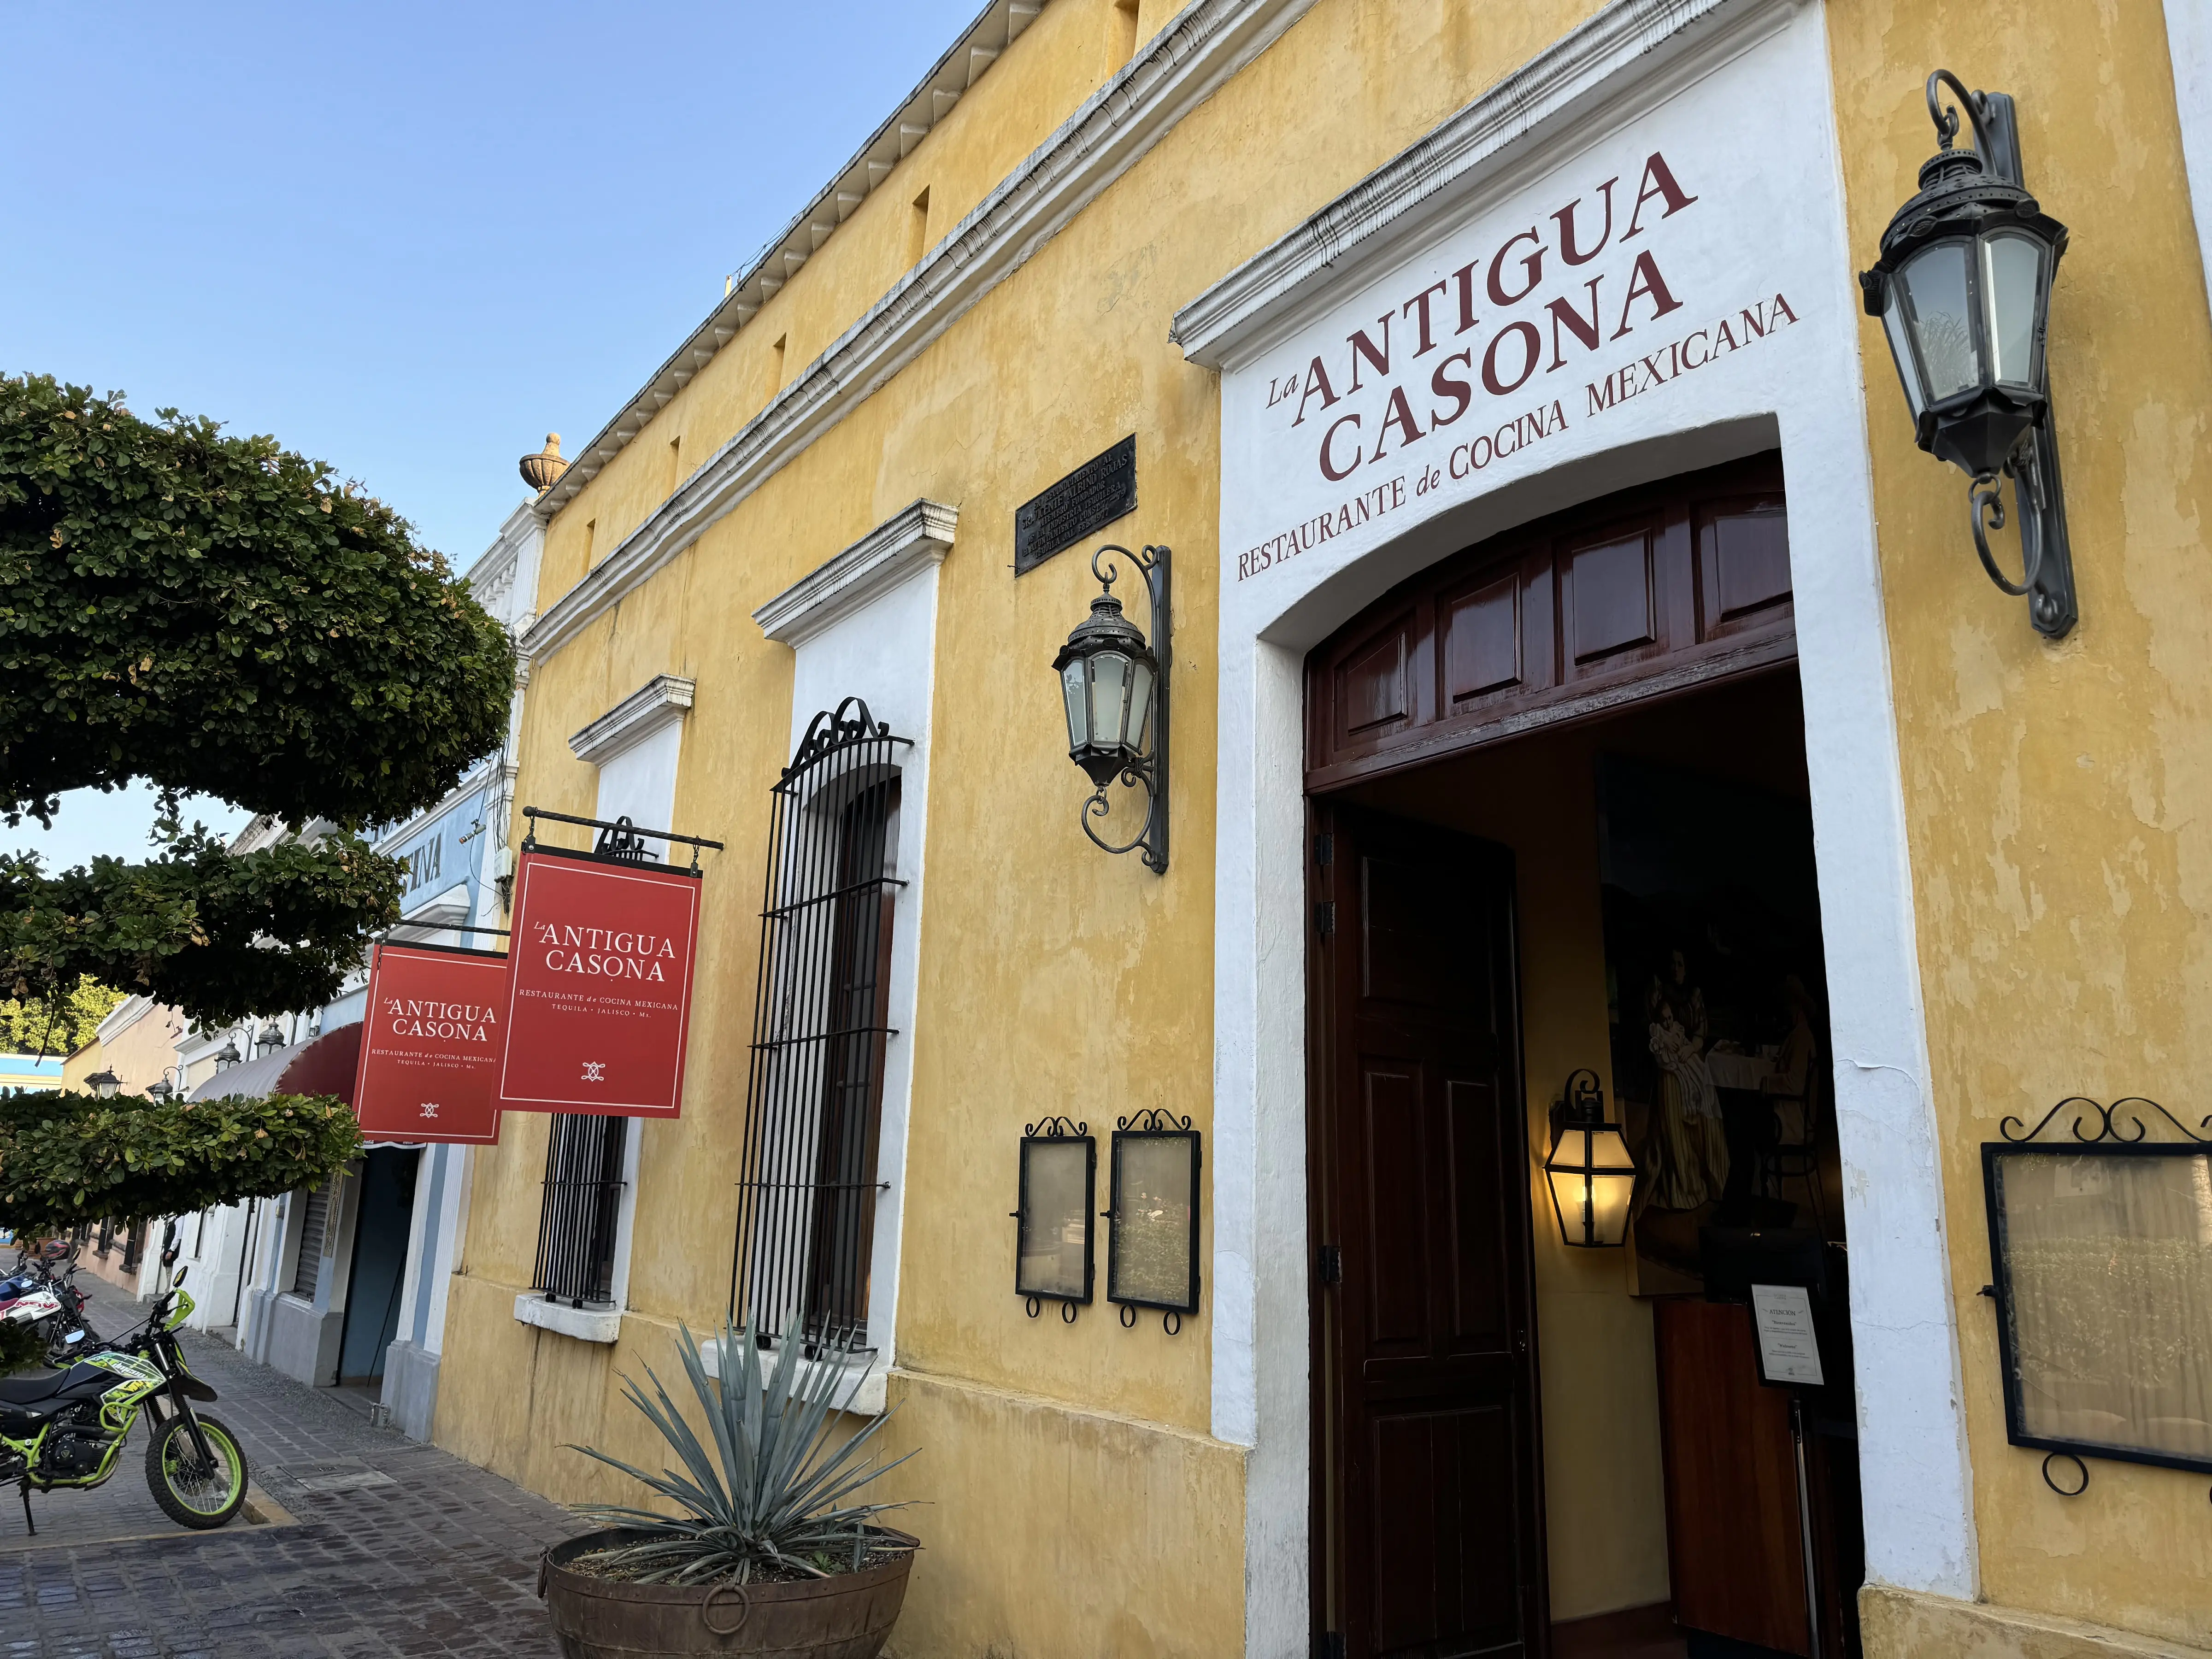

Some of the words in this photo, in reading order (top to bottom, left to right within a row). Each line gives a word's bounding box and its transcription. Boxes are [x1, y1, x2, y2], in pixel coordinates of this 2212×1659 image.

[1265, 375, 1299, 409] La
[1291, 150, 1699, 427] ANTIGUA
[1318, 249, 1683, 482] CASONA
[1238, 476, 1406, 581] RESTAURANTE
[1415, 464, 1440, 497] de
[1449, 399, 1569, 480] COCINA
[1585, 293, 1800, 417] MEXICANA
[1067, 474, 1097, 500] ALBINO
[1101, 454, 1128, 479] ROJAS
[1027, 535, 1034, 545] DE
[1037, 527, 1046, 538] LA
[1048, 506, 1082, 532] INDUSTRIA
[1084, 482, 1121, 508] TEQUILERA
[1040, 503, 1068, 527] MIEMBRO
[1072, 481, 1106, 507] FUNDADOR
[1035, 537, 1060, 559] TEQUILA
[534, 921, 546, 930] La
[539, 924, 676, 959] ANTIGUA
[546, 950, 665, 982] CASONA
[388, 999, 496, 1024] ANTIGUA
[519, 989, 584, 1001] RESTAURANTE
[600, 997, 631, 1006] COCINA
[635, 1000, 678, 1010] MEXICANA
[552, 1004, 587, 1012] TEQUILA
[393, 1018, 488, 1042] CASONA
[372, 1049, 423, 1058] RESTAURANTE
